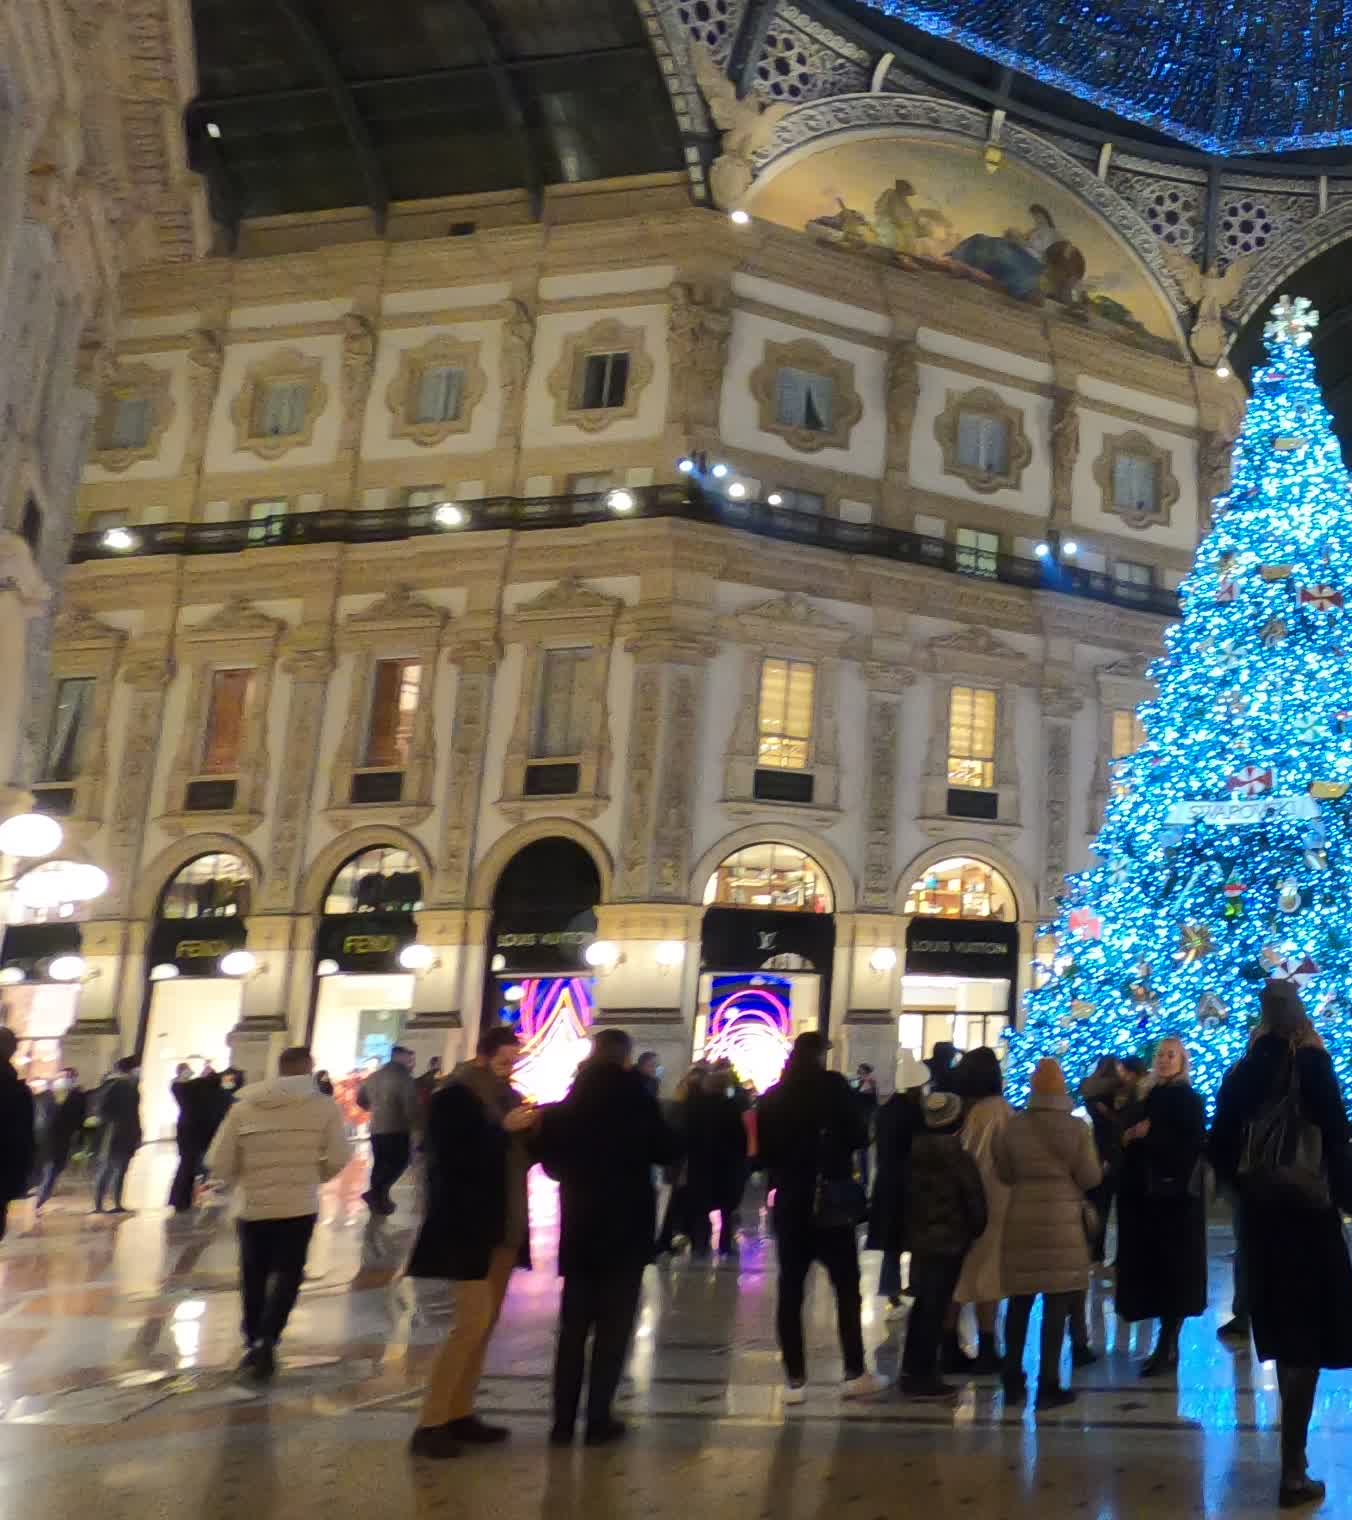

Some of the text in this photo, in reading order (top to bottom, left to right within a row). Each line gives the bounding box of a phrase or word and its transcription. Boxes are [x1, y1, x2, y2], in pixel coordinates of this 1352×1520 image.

[343, 935, 398, 954] FENDI
[497, 933, 537, 948] LOUIS
[912, 940, 1009, 954] LOUIS VUITTON
[176, 940, 231, 958] FENDI
